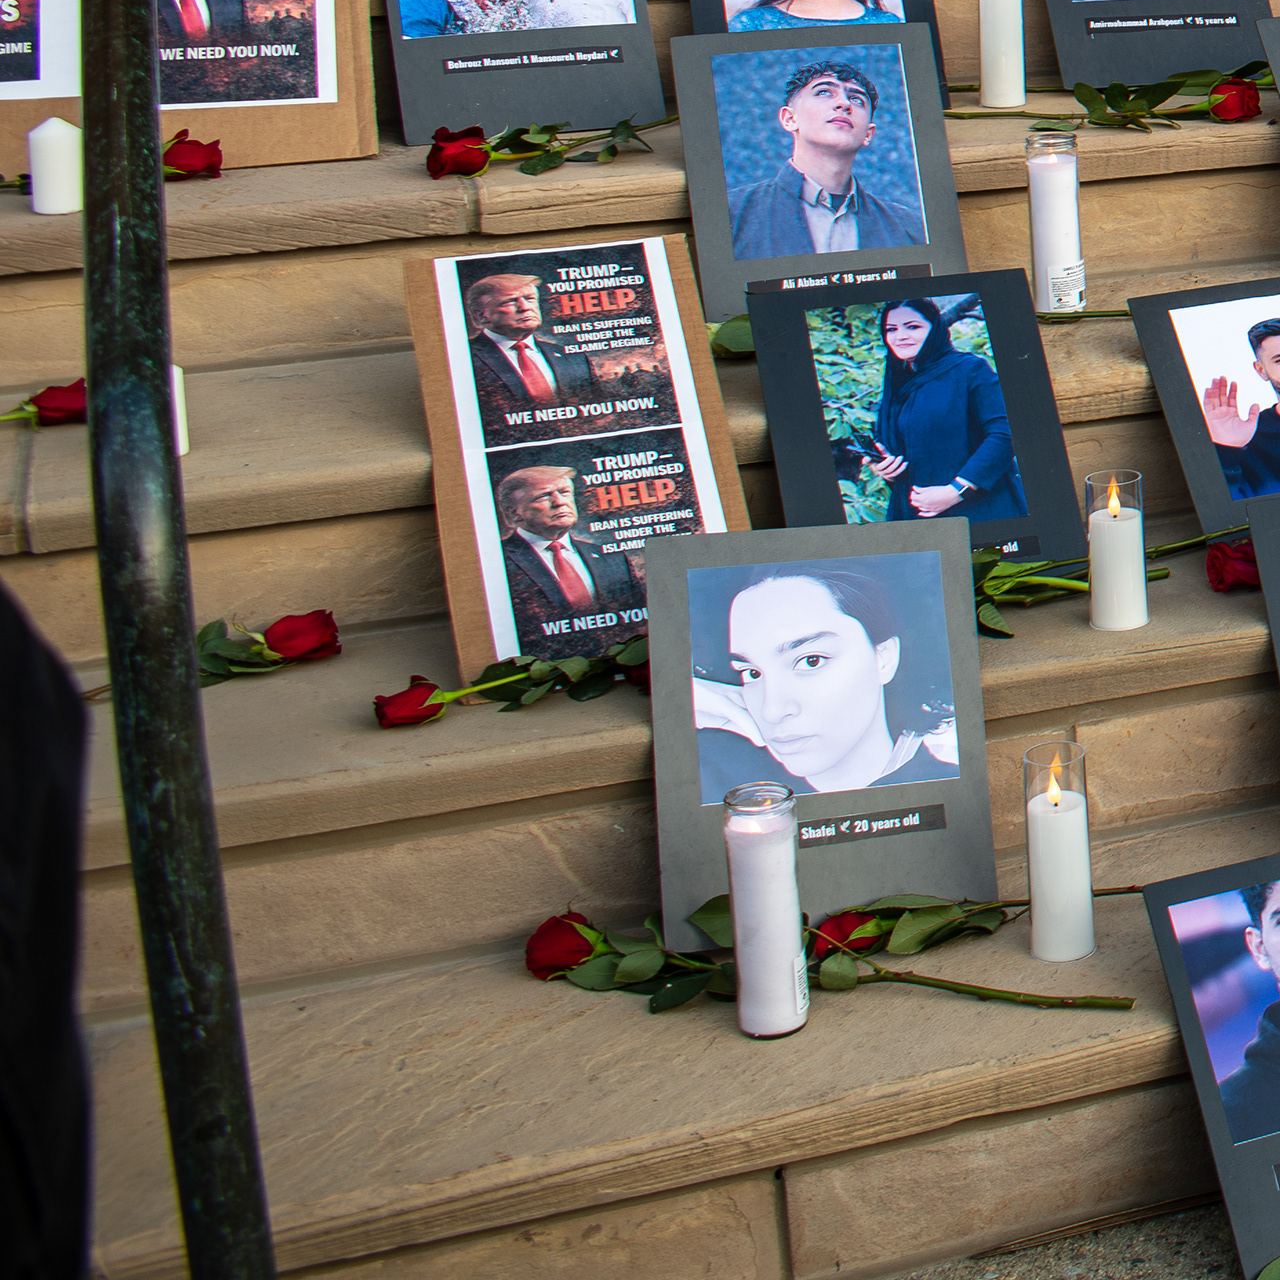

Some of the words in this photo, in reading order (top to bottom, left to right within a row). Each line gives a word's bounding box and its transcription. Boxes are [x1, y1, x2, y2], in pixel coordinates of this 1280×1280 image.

[160, 48, 185, 61] WE
[187, 46, 226, 60] NEED
[228, 45, 258, 58] YOU
[260, 44, 300, 57] NOW.
[547, 279, 579, 294] YOU
[577, 274, 645, 291] PROMISED
[782, 278, 796, 290] Ali
[796, 276, 829, 289] Abbasi
[842, 273, 854, 284] 18
[855, 272, 881, 285] years
[882, 269, 898, 281] old
[560, 289, 637, 315] HELP
[553, 323, 580, 334] IRAN
[581, 322, 592, 333] IS
[593, 316, 652, 331] SUFFERING
[576, 330, 613, 343] UNDER
[614, 328, 635, 339] THE
[564, 340, 609, 354] ISLAMIC
[609, 336, 655, 350] REGIME.
[506, 409, 534, 426] WE
[536, 404, 578, 422] NEED
[579, 402, 614, 419] YOU
[615, 396, 659, 414] NOW.
[582, 469, 615, 486] YOU
[615, 462, 685, 483] PROMISED
[597, 477, 677, 509] HELP
[590, 519, 619, 532] IRAN
[619, 518, 632, 530] IS
[632, 508, 694, 529] SUFFERING
[614, 526, 652, 540] UNDER
[653, 522, 676, 535] THE
[542, 619, 572, 637] WE
[574, 613, 617, 633] NEED
[800, 824, 836, 840] Shafei
[854, 818, 869, 833] 20
[870, 816, 902, 833] years
[902, 812, 920, 826] old
